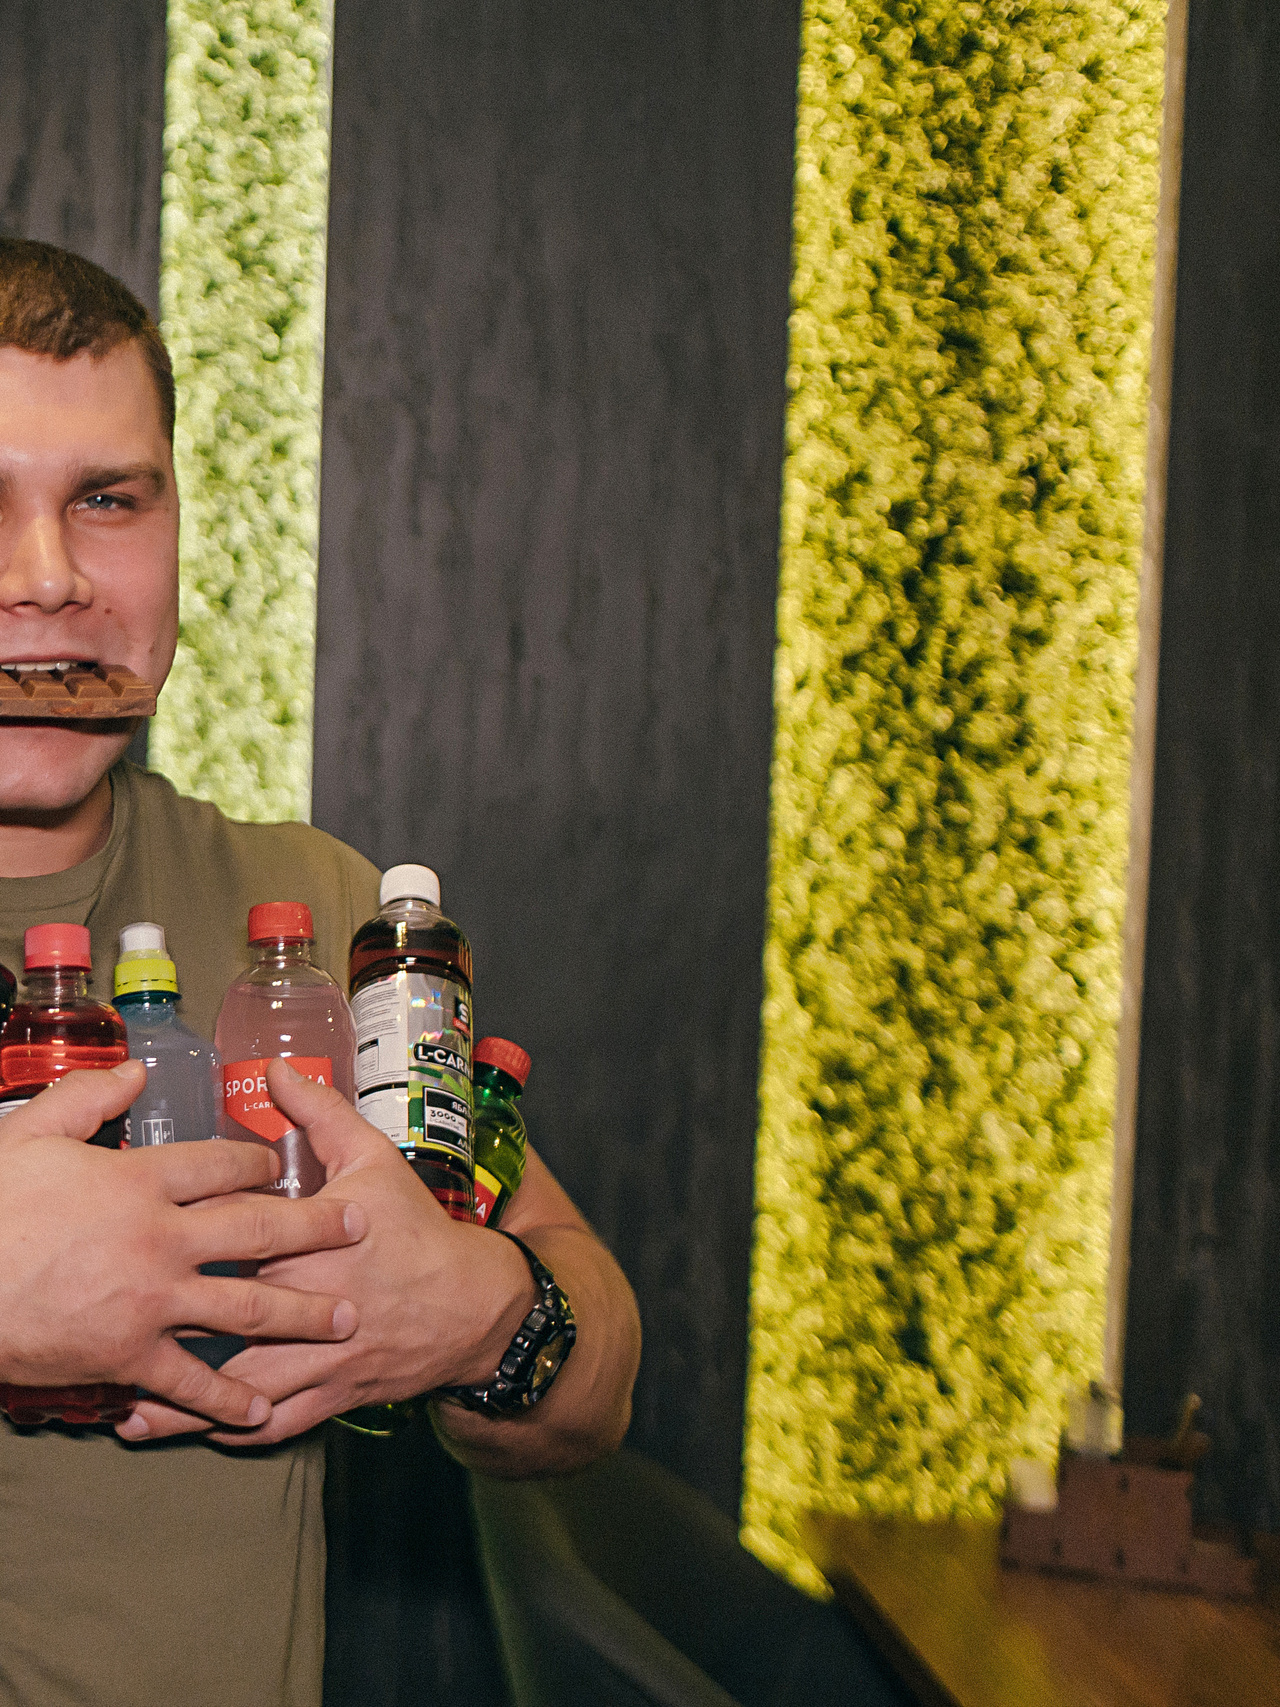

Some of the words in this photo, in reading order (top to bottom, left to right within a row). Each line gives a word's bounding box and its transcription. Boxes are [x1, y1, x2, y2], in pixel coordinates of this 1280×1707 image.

[225, 1075, 326, 1098] SPORA
[430, 1109, 457, 1123] 3000
[270, 1178, 302, 1190] URA
